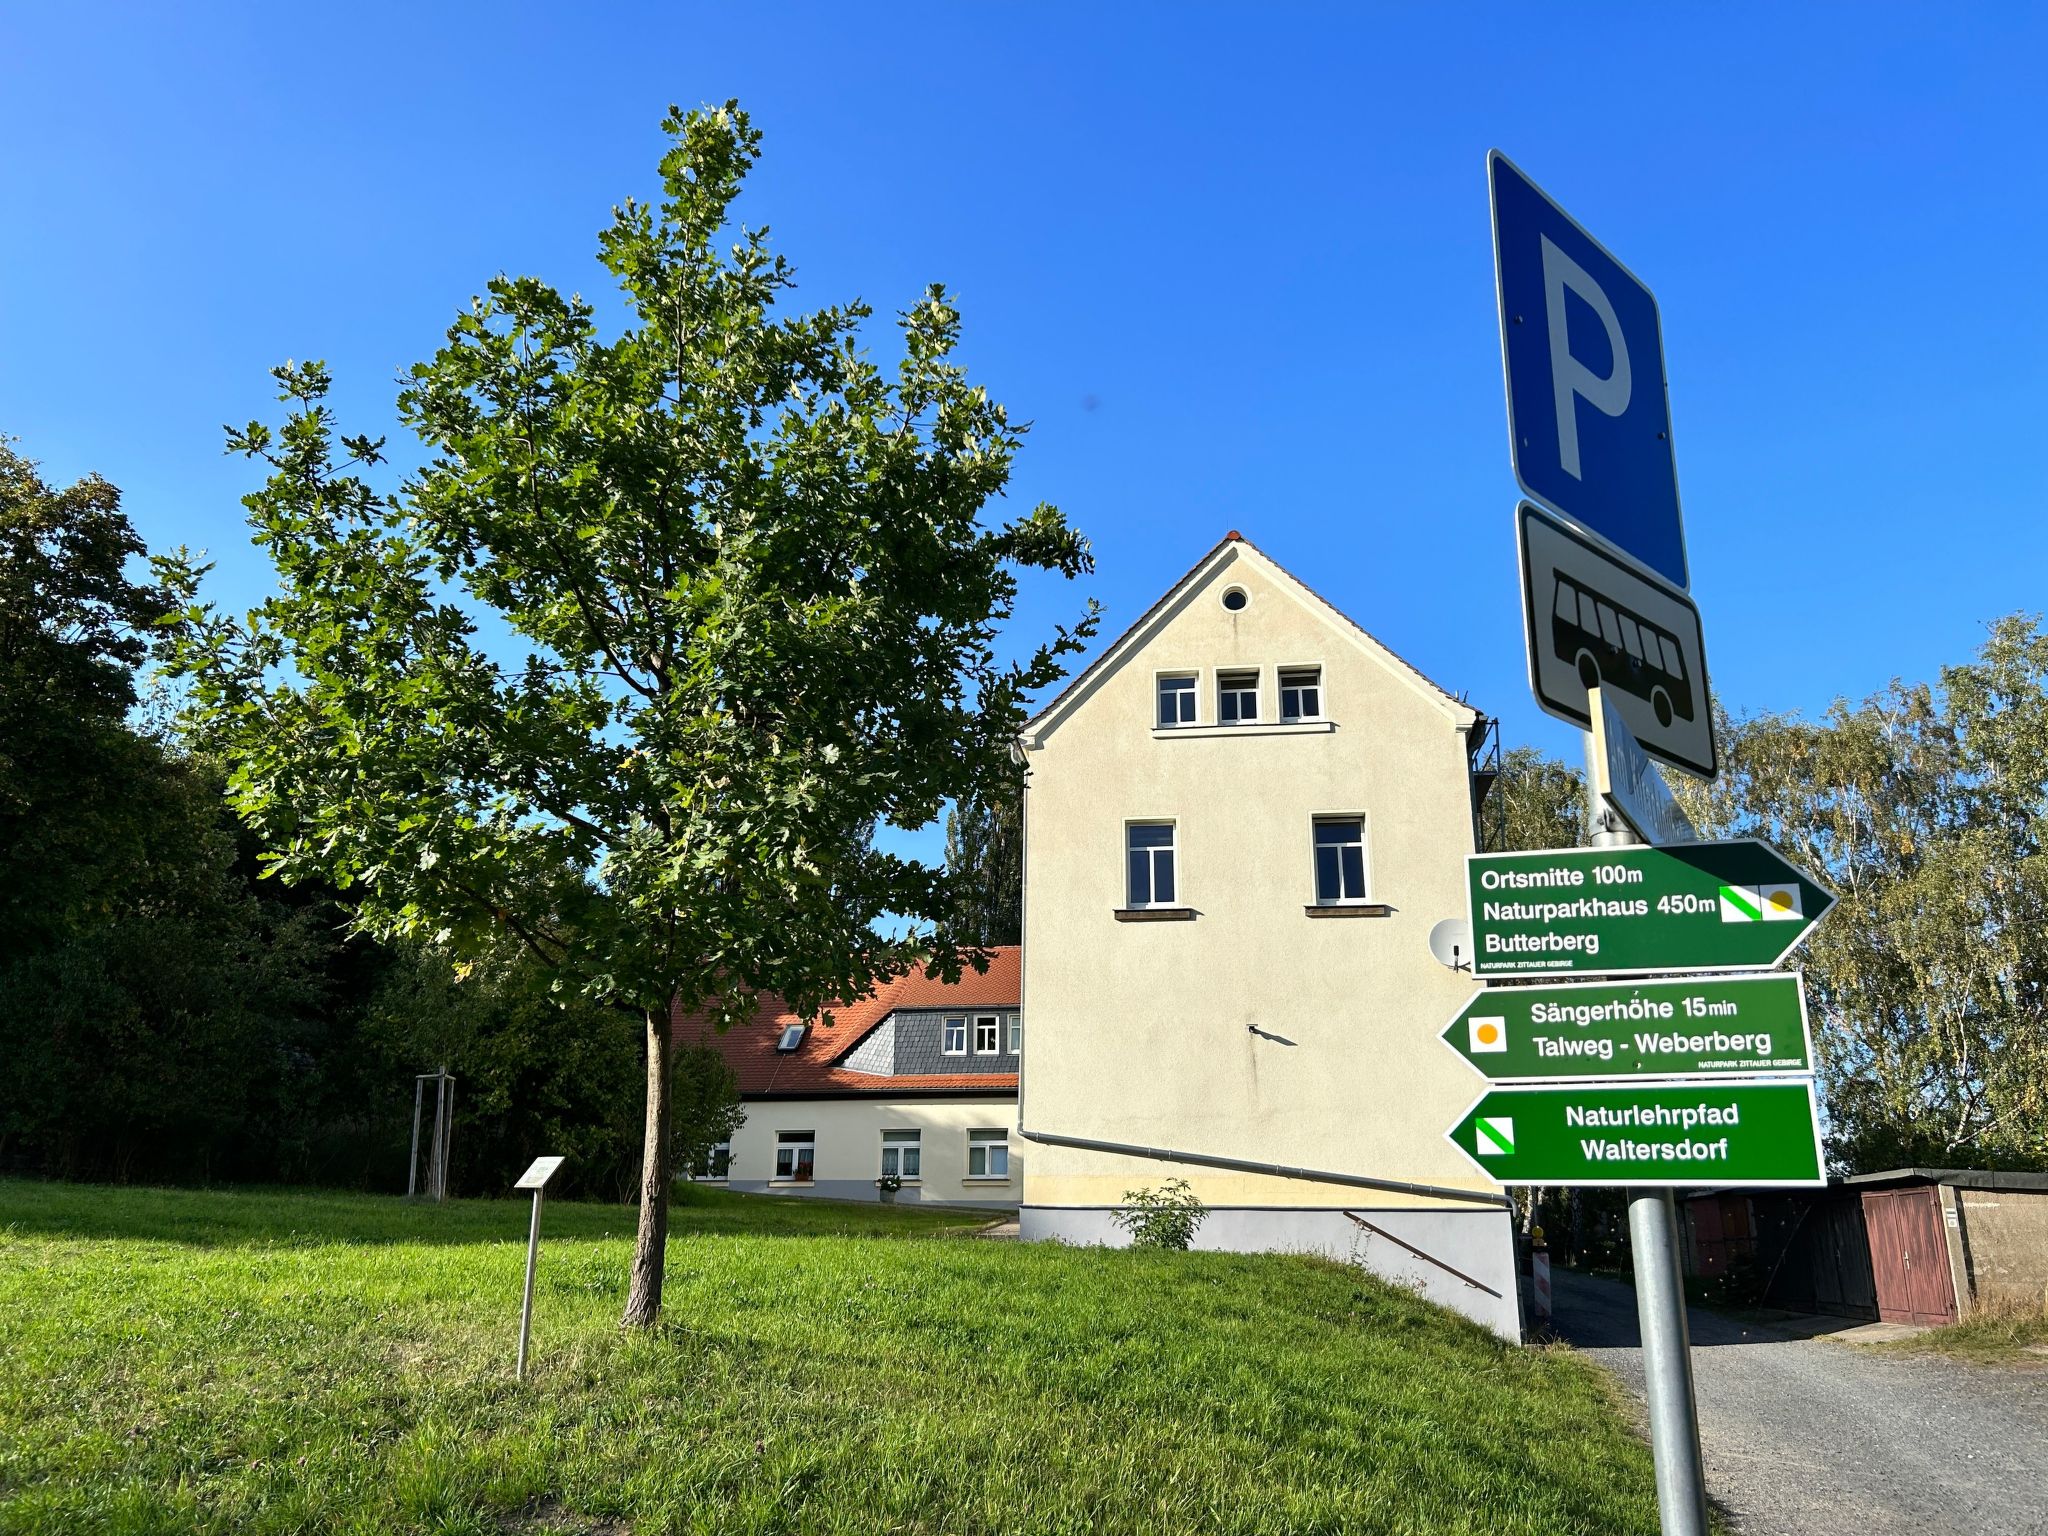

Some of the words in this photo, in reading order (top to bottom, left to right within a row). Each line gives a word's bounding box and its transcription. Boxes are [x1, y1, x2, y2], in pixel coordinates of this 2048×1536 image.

[1540, 232, 1632, 482] P
[1480, 866, 1585, 890] Ortsmitte
[1591, 863, 1644, 885] 100m
[1483, 896, 1649, 924] Naturparkhaus
[1656, 893, 1716, 914] 450m
[1485, 931, 1600, 955] Butterberg
[1480, 961, 1516, 970] NATURPARK
[1517, 960, 1546, 969] ZITTAUER
[1546, 959, 1574, 968] GEBIRGE
[1530, 998, 1674, 1027] Sängerhöhe
[1532, 1036, 1614, 1061] Talweg
[1619, 1043, 1629, 1051] -
[1633, 1030, 1772, 1056] Weberberg
[1697, 1059, 1738, 1069] NATURPARK
[1739, 1058, 1772, 1068] ZITTAUER
[1772, 1057, 1803, 1067] GEBIRGE
[1566, 1102, 1739, 1130] Naturlehrpfad
[1580, 1137, 1728, 1160] Waltersdorf
